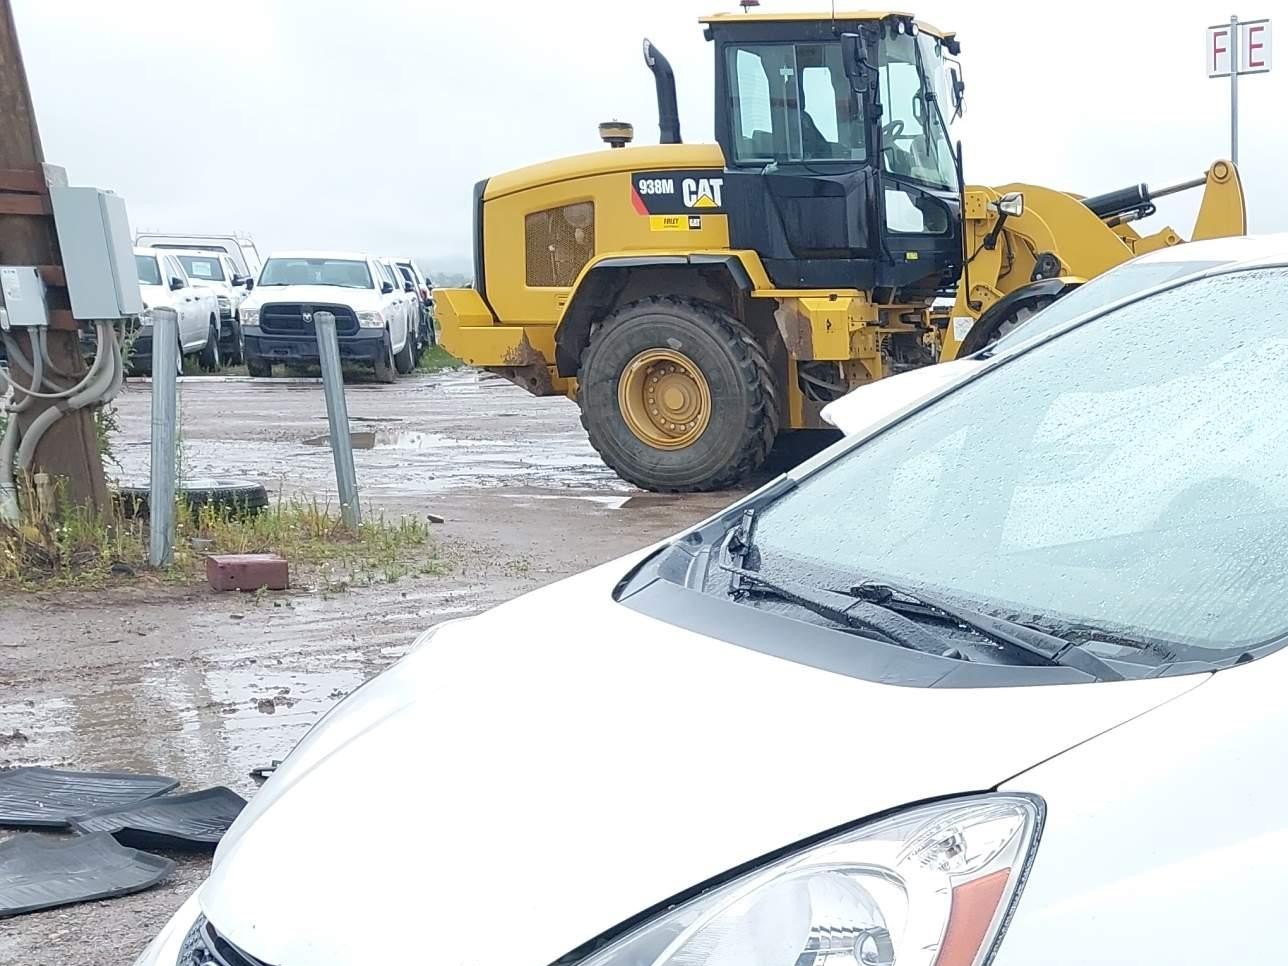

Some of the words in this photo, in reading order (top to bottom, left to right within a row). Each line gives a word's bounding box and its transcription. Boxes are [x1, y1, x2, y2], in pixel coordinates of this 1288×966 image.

[1213, 31, 1228, 71] F
[1249, 26, 1264, 67] E
[638, 179, 675, 195] 938M
[681, 178, 724, 208] CAT
